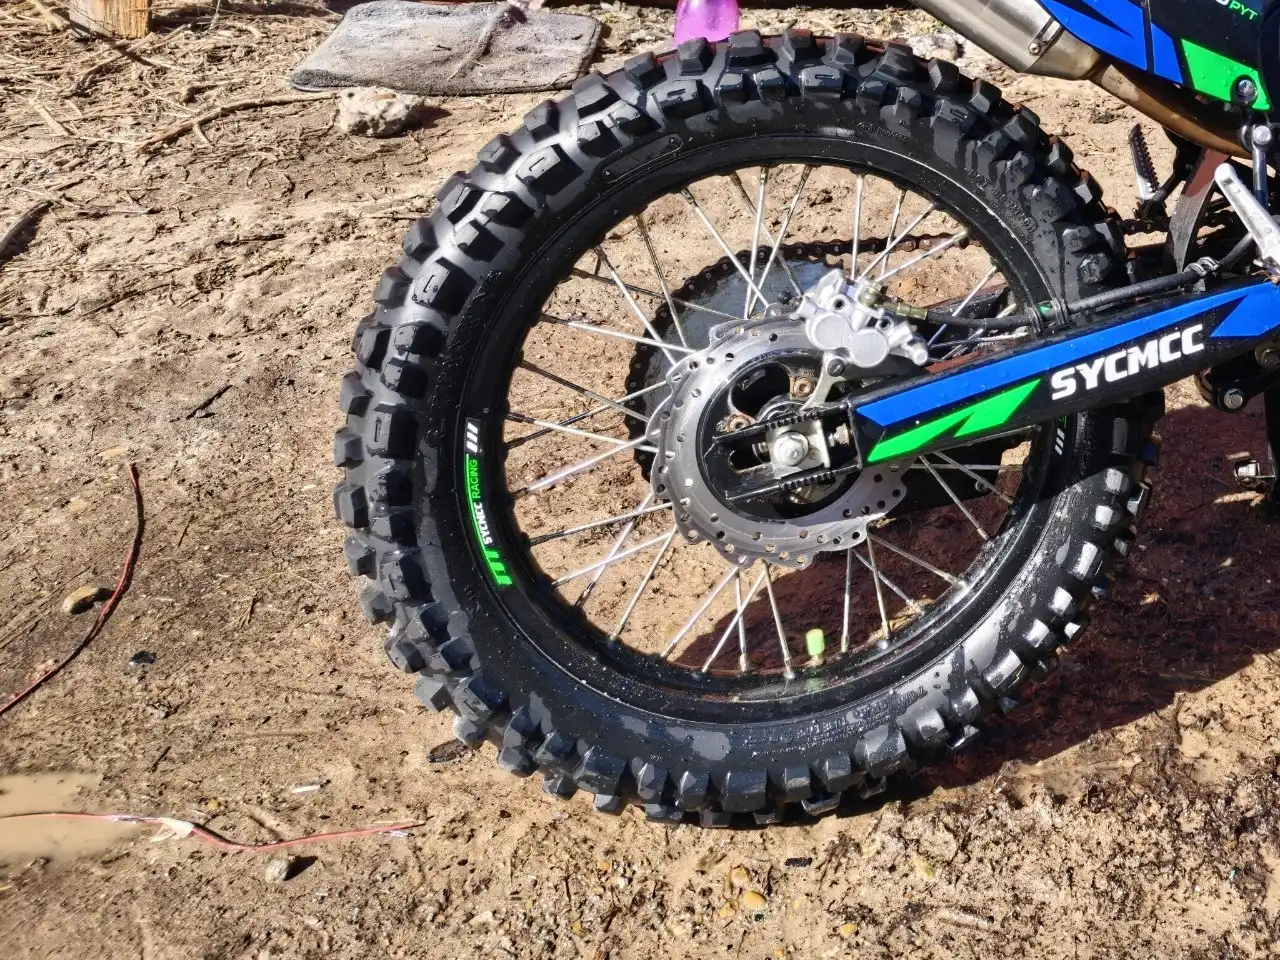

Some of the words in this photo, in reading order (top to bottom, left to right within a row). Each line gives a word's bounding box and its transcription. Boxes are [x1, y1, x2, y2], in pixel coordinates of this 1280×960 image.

[1051, 323, 1204, 401] SYCMCC
[469, 459, 481, 499] RACING
[473, 501, 493, 545] SYCMCC
